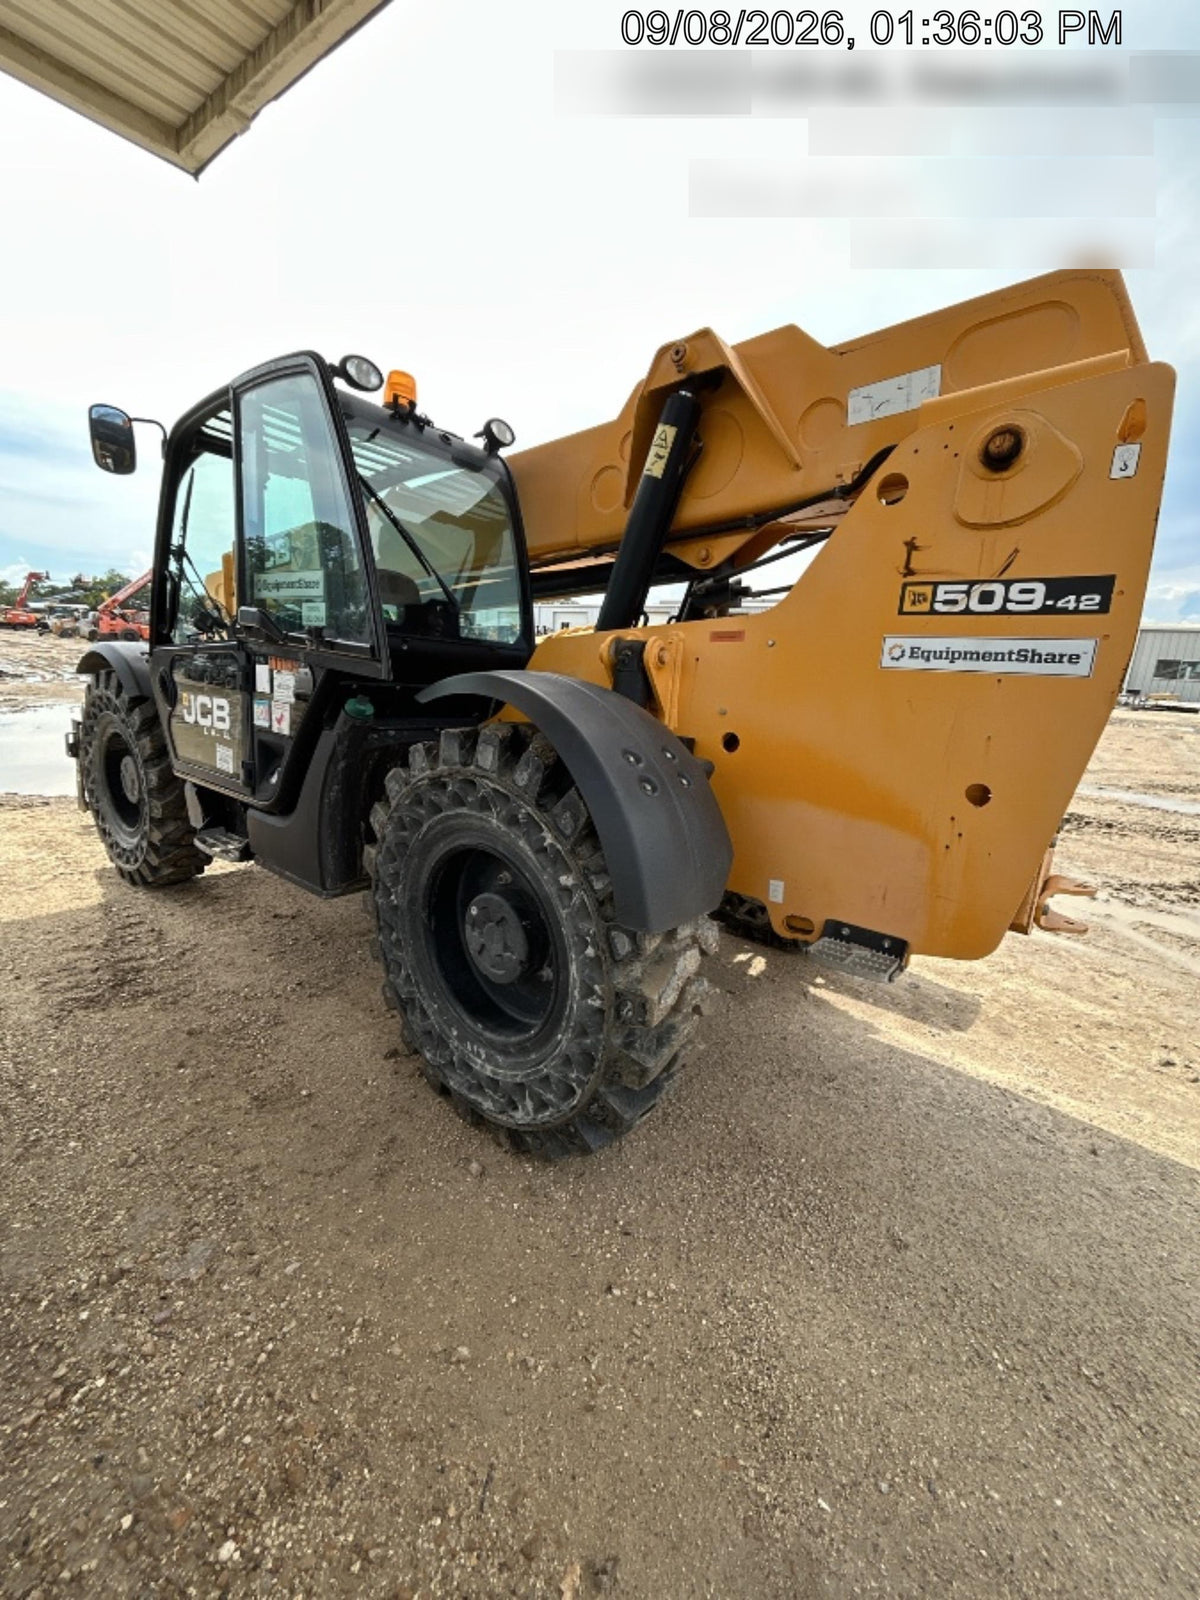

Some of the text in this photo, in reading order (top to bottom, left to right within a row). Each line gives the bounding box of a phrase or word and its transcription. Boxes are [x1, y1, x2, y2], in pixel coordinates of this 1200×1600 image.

[933, 582, 1101, 612] 509-42
[908, 646, 1081, 665] EquipmentShare
[183, 694, 230, 730] JCB
